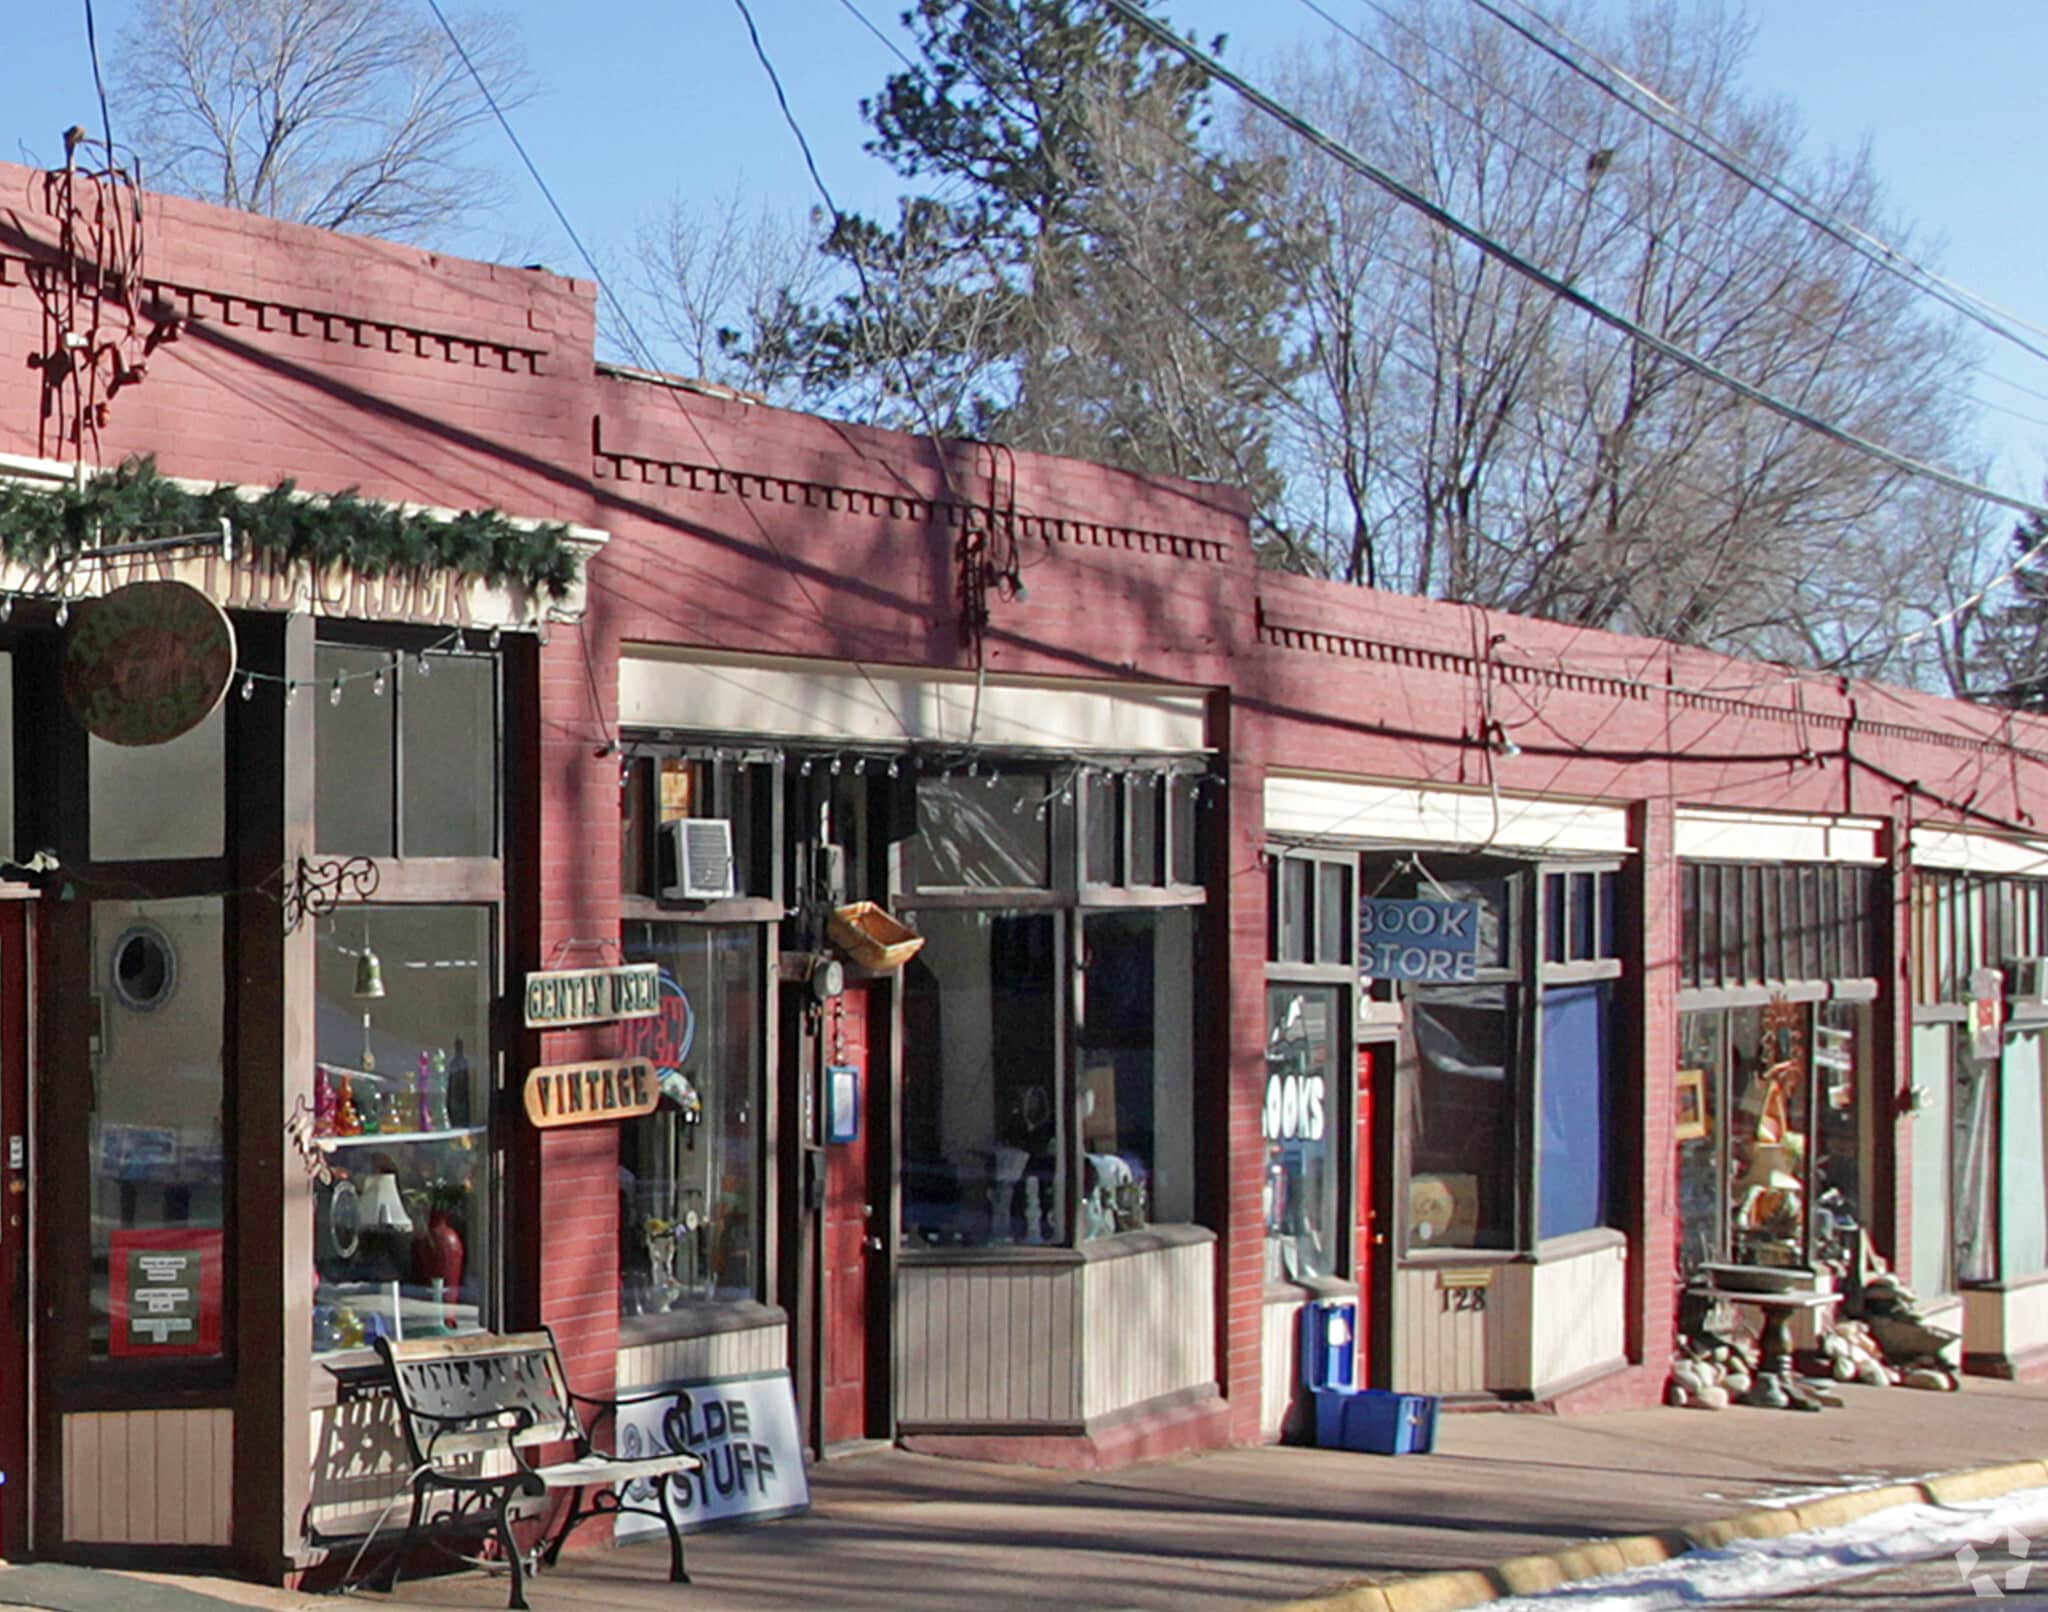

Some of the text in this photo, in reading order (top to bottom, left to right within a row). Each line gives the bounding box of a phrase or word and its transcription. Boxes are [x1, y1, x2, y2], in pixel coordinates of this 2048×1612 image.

[1359, 904, 1471, 937] BOOK
[1359, 942, 1476, 981] STORE
[528, 971, 657, 1020] GENTLY USED
[537, 1065, 648, 1116] VINTAGE
[1262, 1074, 1325, 1140] OOKS
[1440, 1286, 1486, 1312] 128
[662, 1399, 750, 1448] OLDE
[671, 1442, 775, 1508] STUFF
